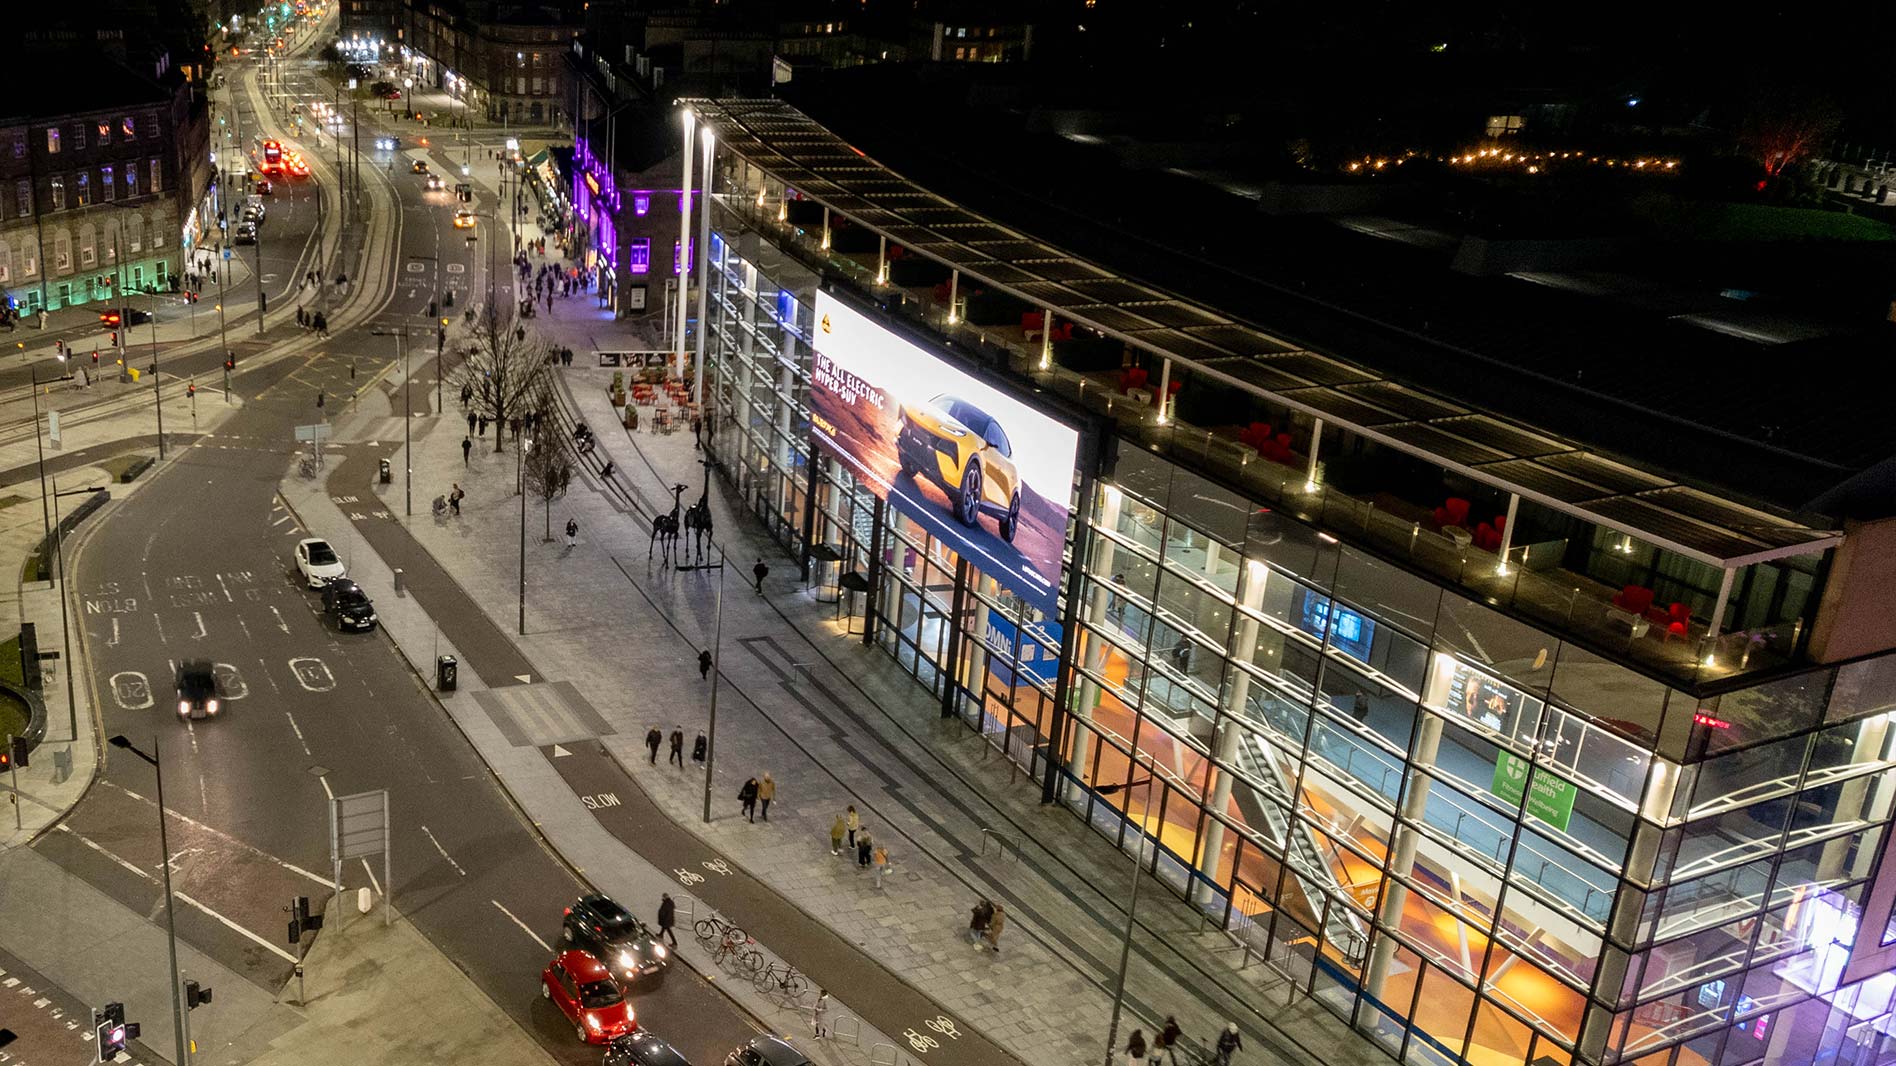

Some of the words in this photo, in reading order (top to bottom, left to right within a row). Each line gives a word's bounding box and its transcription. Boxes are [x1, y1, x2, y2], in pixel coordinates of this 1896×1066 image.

[815, 367, 857, 406] HYPER-SUV
[816, 353, 831, 373] THE
[831, 363, 845, 384] ALL
[846, 373, 884, 410] ELECTRIC
[1532, 780, 1556, 799] ealth
[1535, 768, 1566, 793] uffield
[581, 792, 621, 810] SLOW
